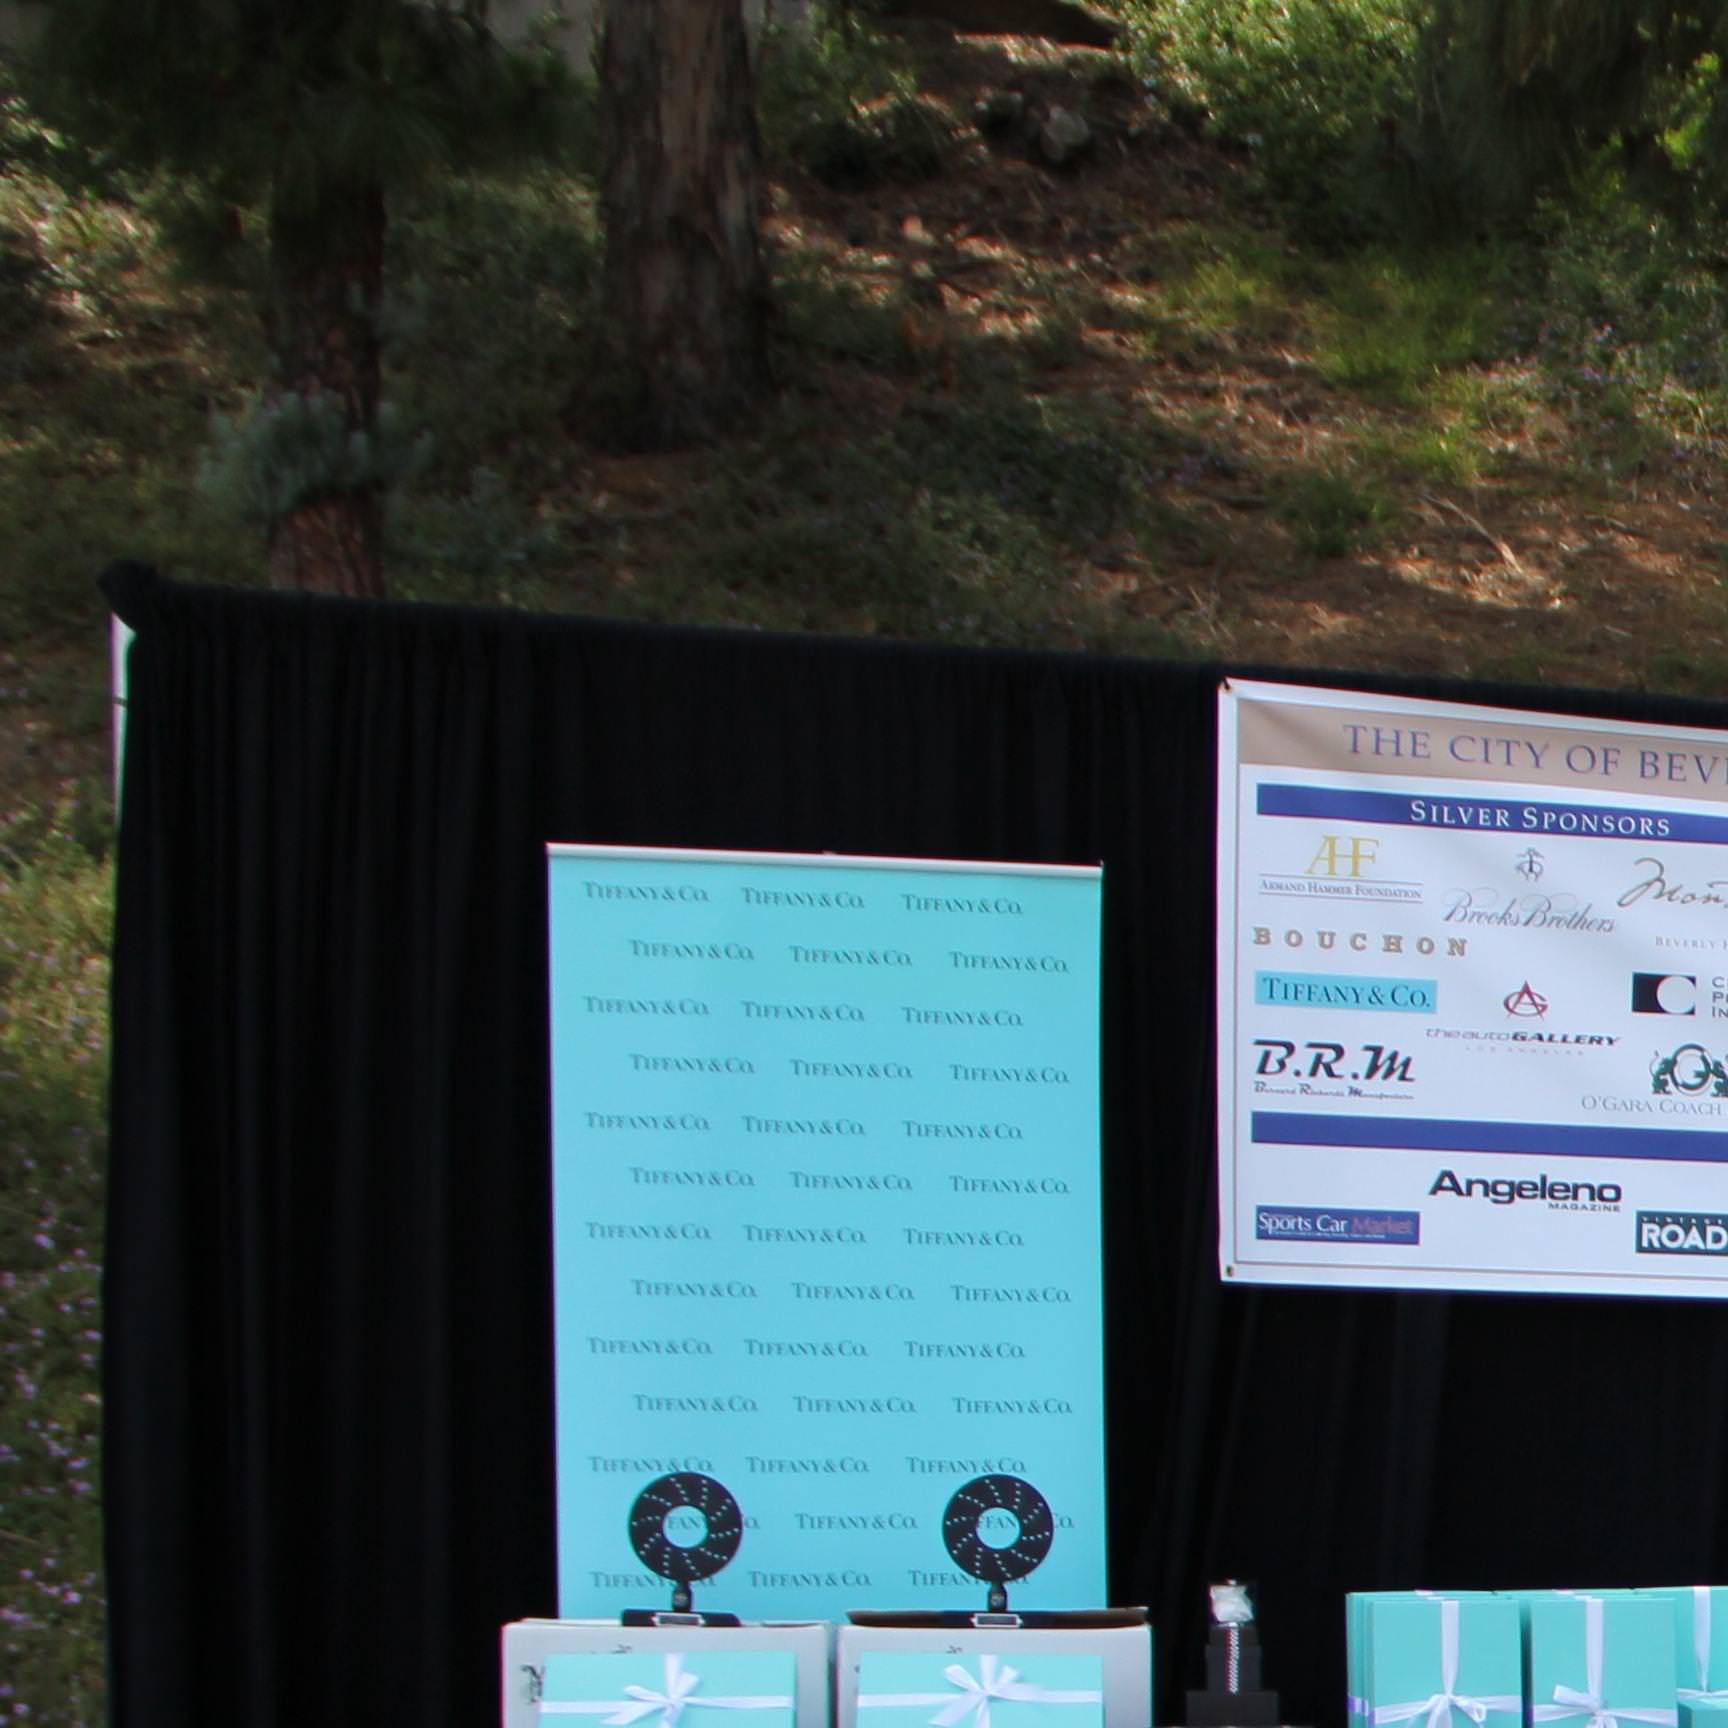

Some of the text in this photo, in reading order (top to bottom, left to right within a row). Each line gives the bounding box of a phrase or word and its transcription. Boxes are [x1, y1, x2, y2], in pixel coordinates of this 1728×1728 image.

[1343, 723, 1432, 760] THE
[1449, 734, 1549, 769] CITY
[1565, 743, 1623, 776] OF
[1410, 800, 1670, 837] SILVER SPONSORS
[1253, 926, 1468, 957] BOUCHON
[1263, 976, 1364, 1005] TIFFANY
[1367, 986, 1386, 1006] &
[1581, 1095, 1653, 1113] O'GARA
[1659, 1099, 1721, 1116] COACH
[1428, 1170, 1622, 1205] Angeleno
[1548, 1202, 1621, 1213] MAGAZINE
[1259, 1212, 1312, 1234] Sports
[1316, 1214, 1348, 1233] Car
